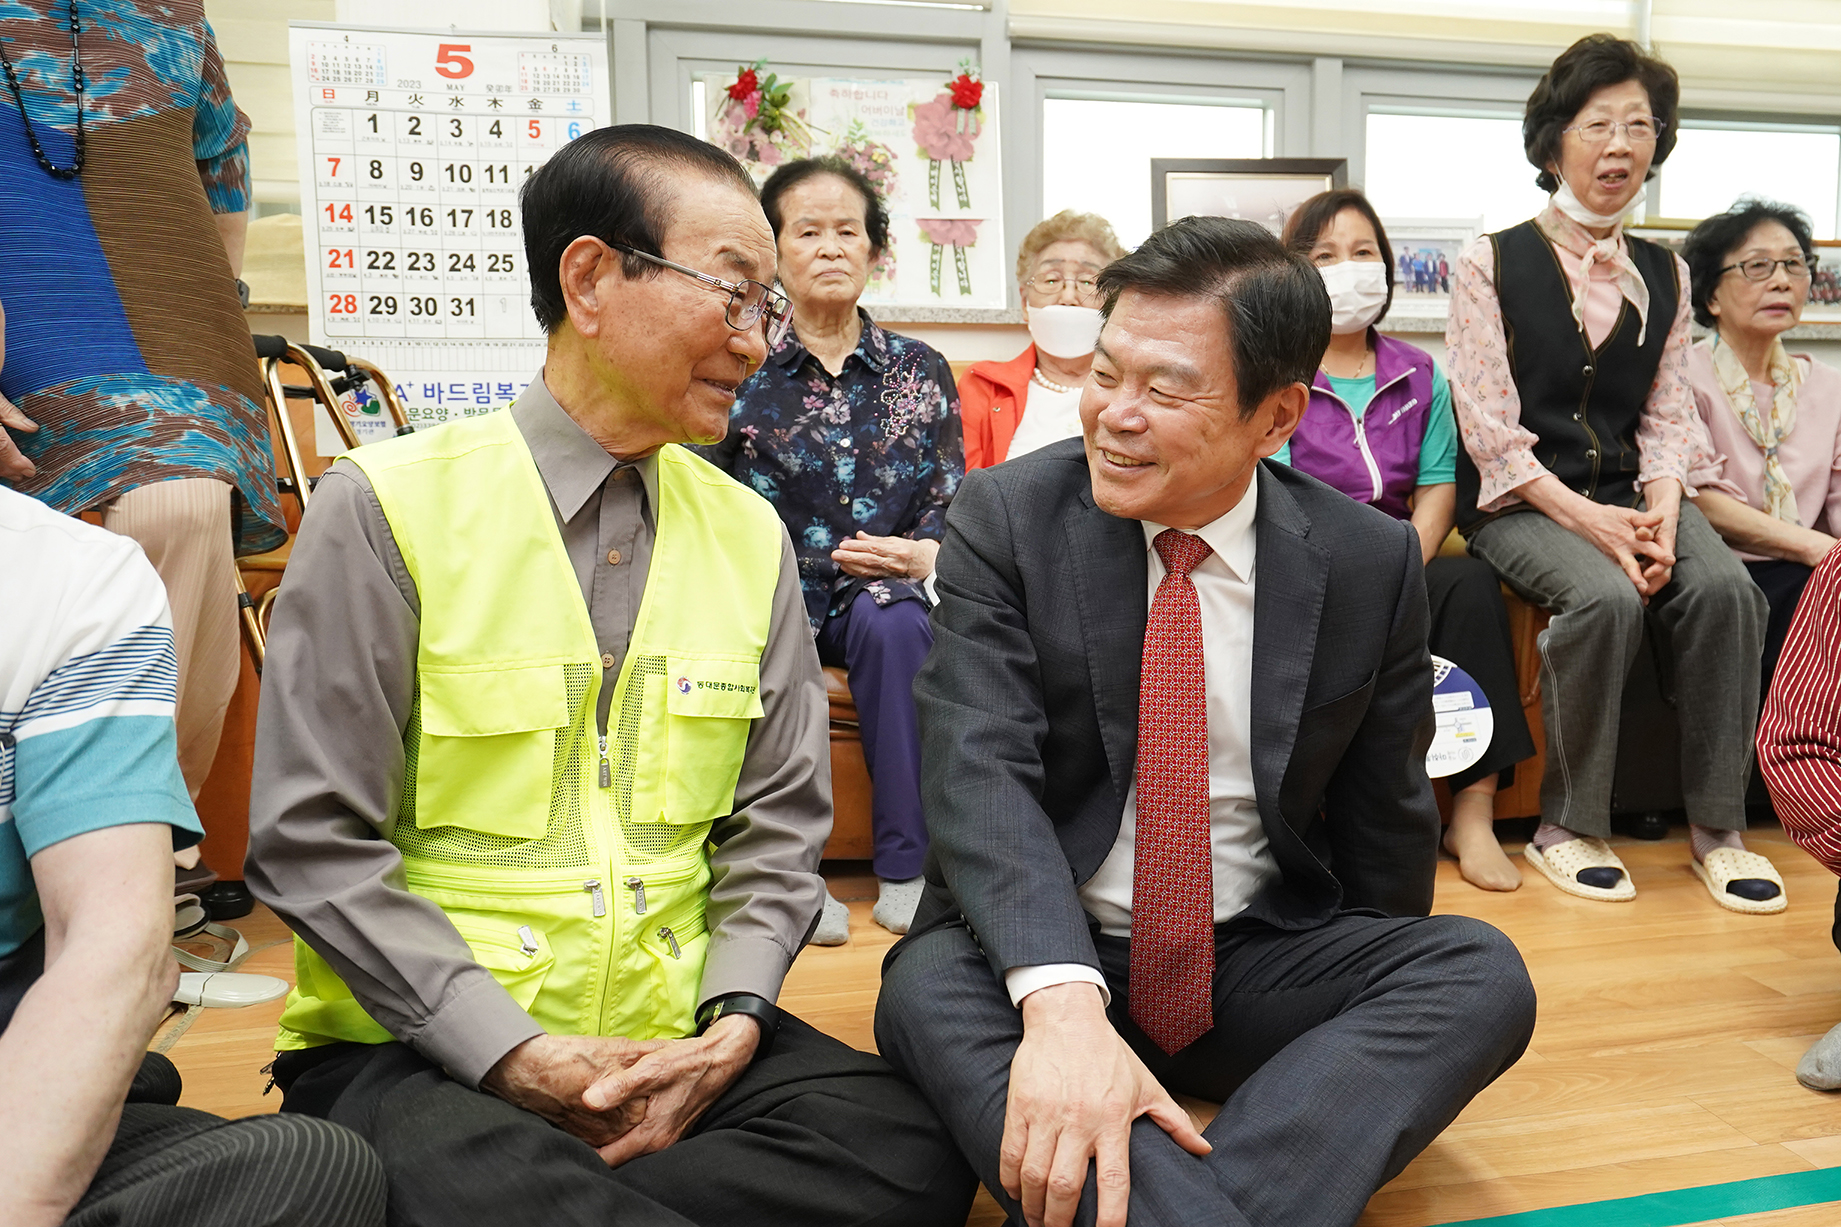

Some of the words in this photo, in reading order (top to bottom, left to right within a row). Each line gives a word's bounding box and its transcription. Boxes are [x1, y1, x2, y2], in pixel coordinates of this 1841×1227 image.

[344, 35, 349, 43] 4
[551, 44, 558, 53] 6
[434, 44, 475, 80] 5
[397, 79, 421, 89] 2023
[829, 88, 889, 101] 축하합니다
[322, 88, 335, 99] 日
[365, 90, 379, 102] 月
[408, 93, 424, 106] 火
[449, 96, 464, 107] 水
[487, 97, 503, 109] 木
[527, 98, 543, 110] 金
[566, 100, 582, 111] 土
[861, 104, 905, 117] 어버이날
[368, 113, 378, 134] 1
[408, 116, 422, 136] 2
[449, 119, 463, 138] 3
[489, 120, 503, 139] 4
[528, 120, 541, 139] 5
[568, 122, 581, 141] 6
[327, 158, 341, 177] 7
[369, 160, 383, 180] 8
[410, 162, 424, 181] 9
[445, 164, 472, 183] 10
[484, 165, 509, 183] 11
[325, 203, 354, 223] 14
[365, 205, 394, 226] 15
[405, 207, 434, 227] 16
[447, 209, 474, 228] 17
[486, 210, 513, 228] 18
[328, 249, 354, 269] 21
[367, 251, 396, 270] 22
[407, 252, 436, 271] 23
[448, 254, 476, 272] 24
[487, 254, 514, 272] 25
[329, 294, 358, 314] 28
[369, 296, 398, 315] 29
[409, 297, 438, 316] 30
[450, 298, 475, 317] 31
[403, 407, 449, 422] 문요양
